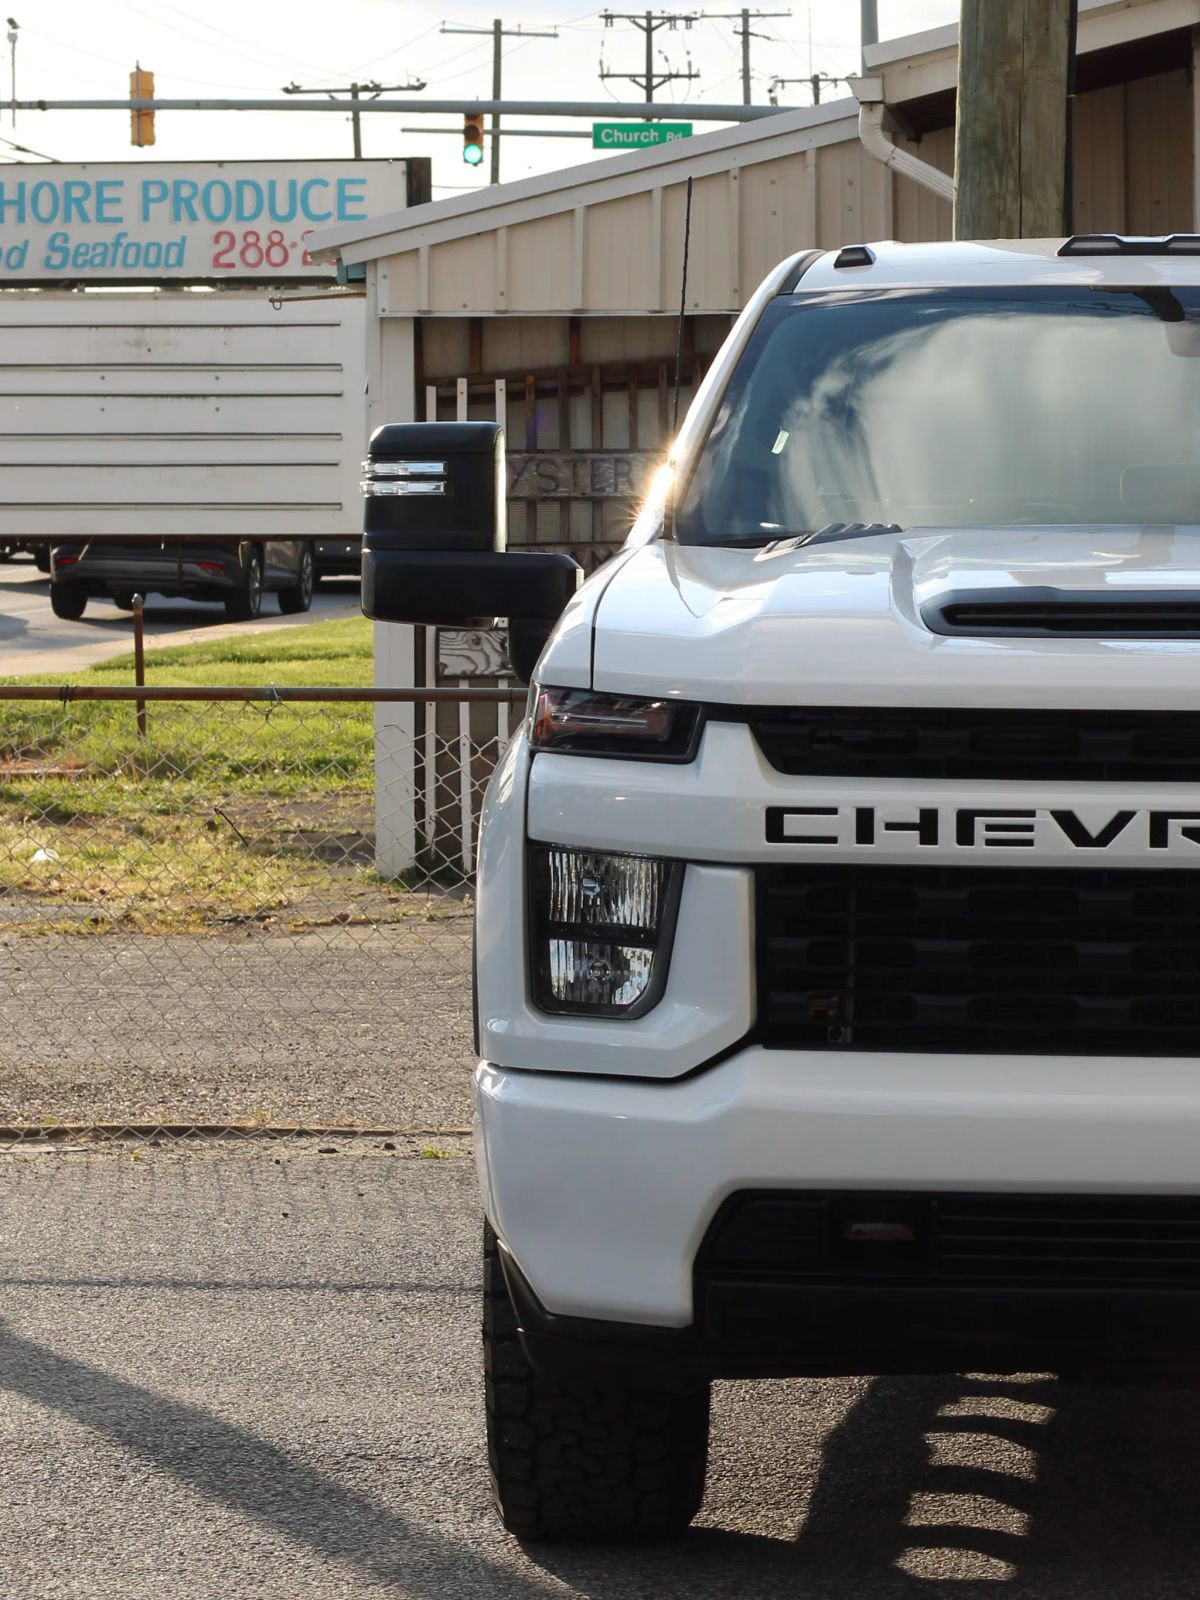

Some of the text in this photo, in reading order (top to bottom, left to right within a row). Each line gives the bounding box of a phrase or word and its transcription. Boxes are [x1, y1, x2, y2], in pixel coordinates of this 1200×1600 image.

[601, 128, 659, 143] Church
[0, 178, 368, 224] HORE PRODUCE
[43, 231, 187, 270] Seafood
